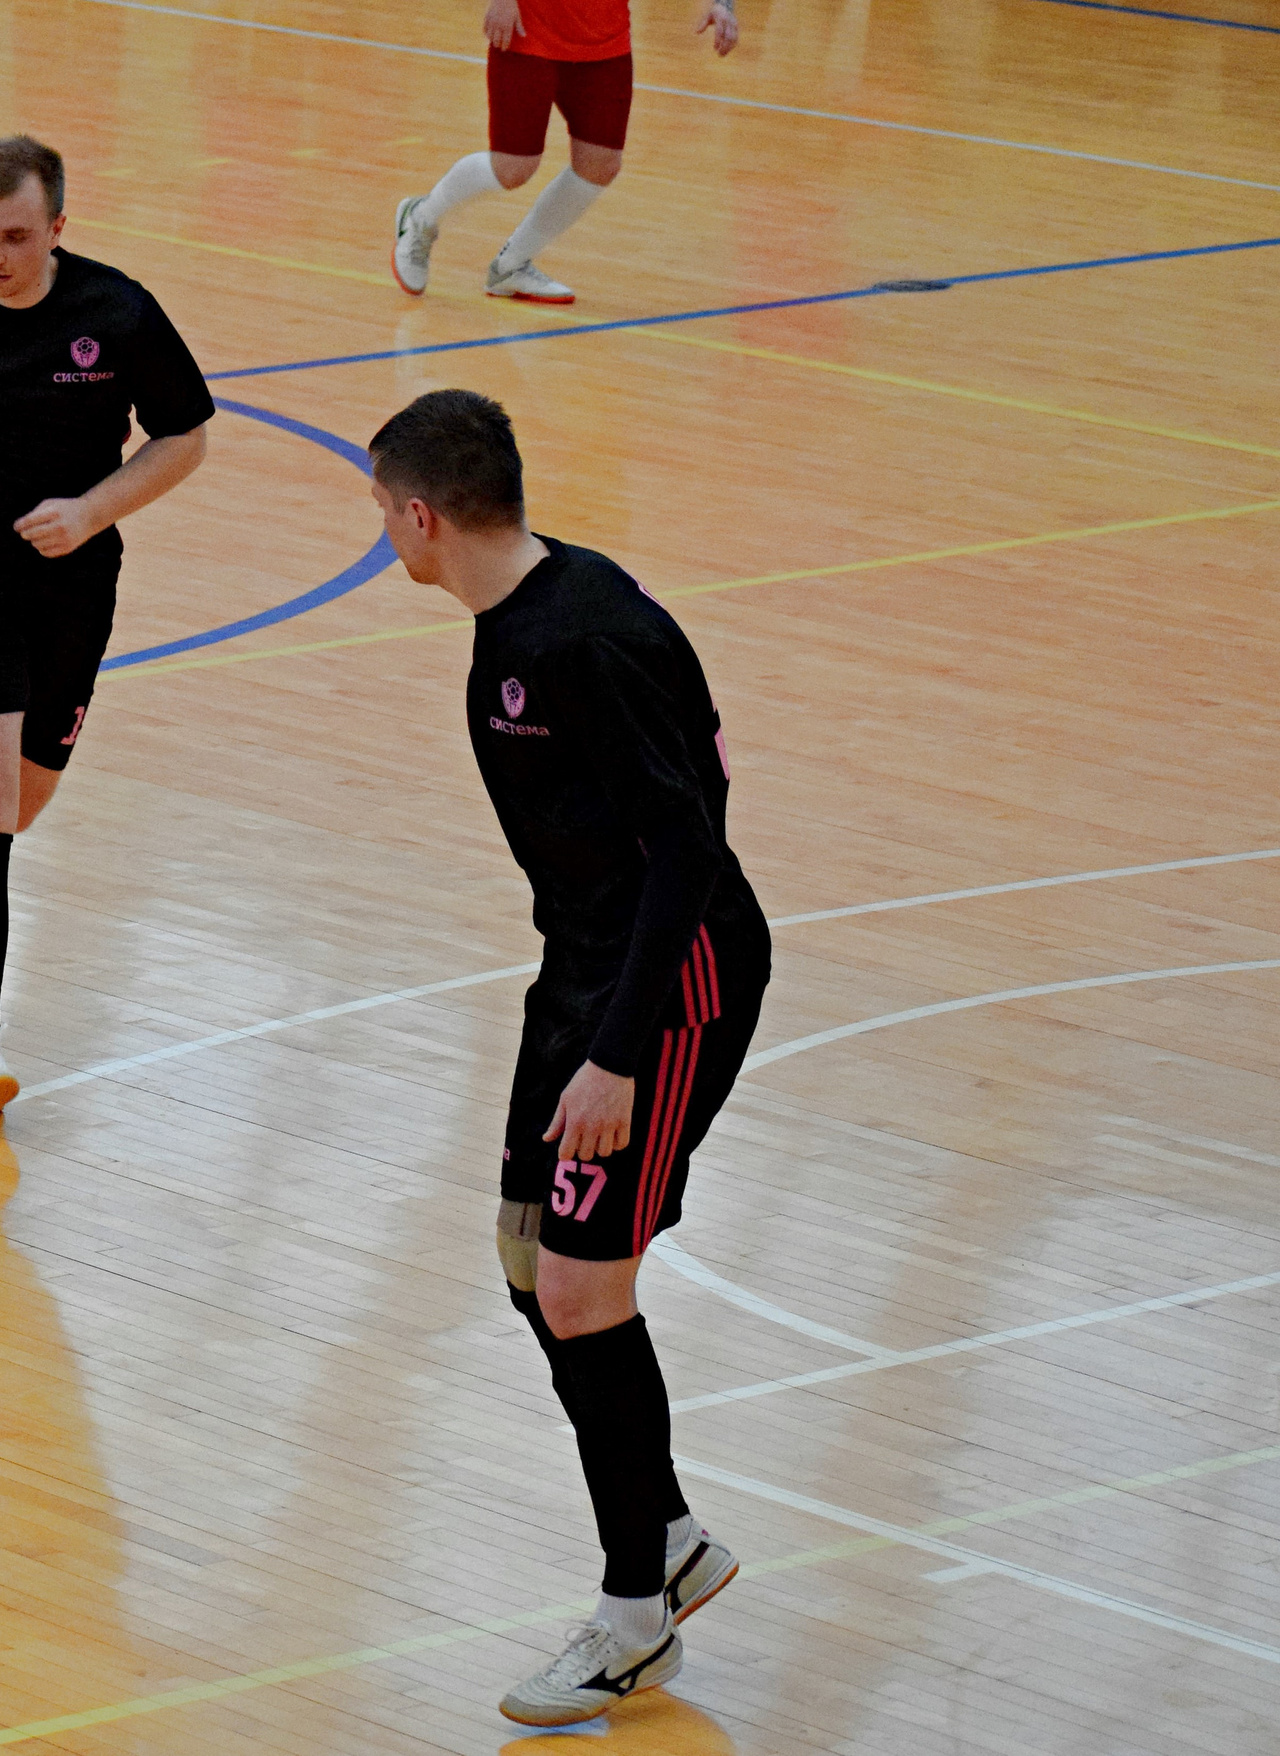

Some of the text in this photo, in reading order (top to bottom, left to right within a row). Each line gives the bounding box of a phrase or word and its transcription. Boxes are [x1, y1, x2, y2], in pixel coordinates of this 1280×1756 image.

[53, 372, 114, 383] система
[489, 716, 550, 736] система
[551, 1160, 608, 1222] 57
